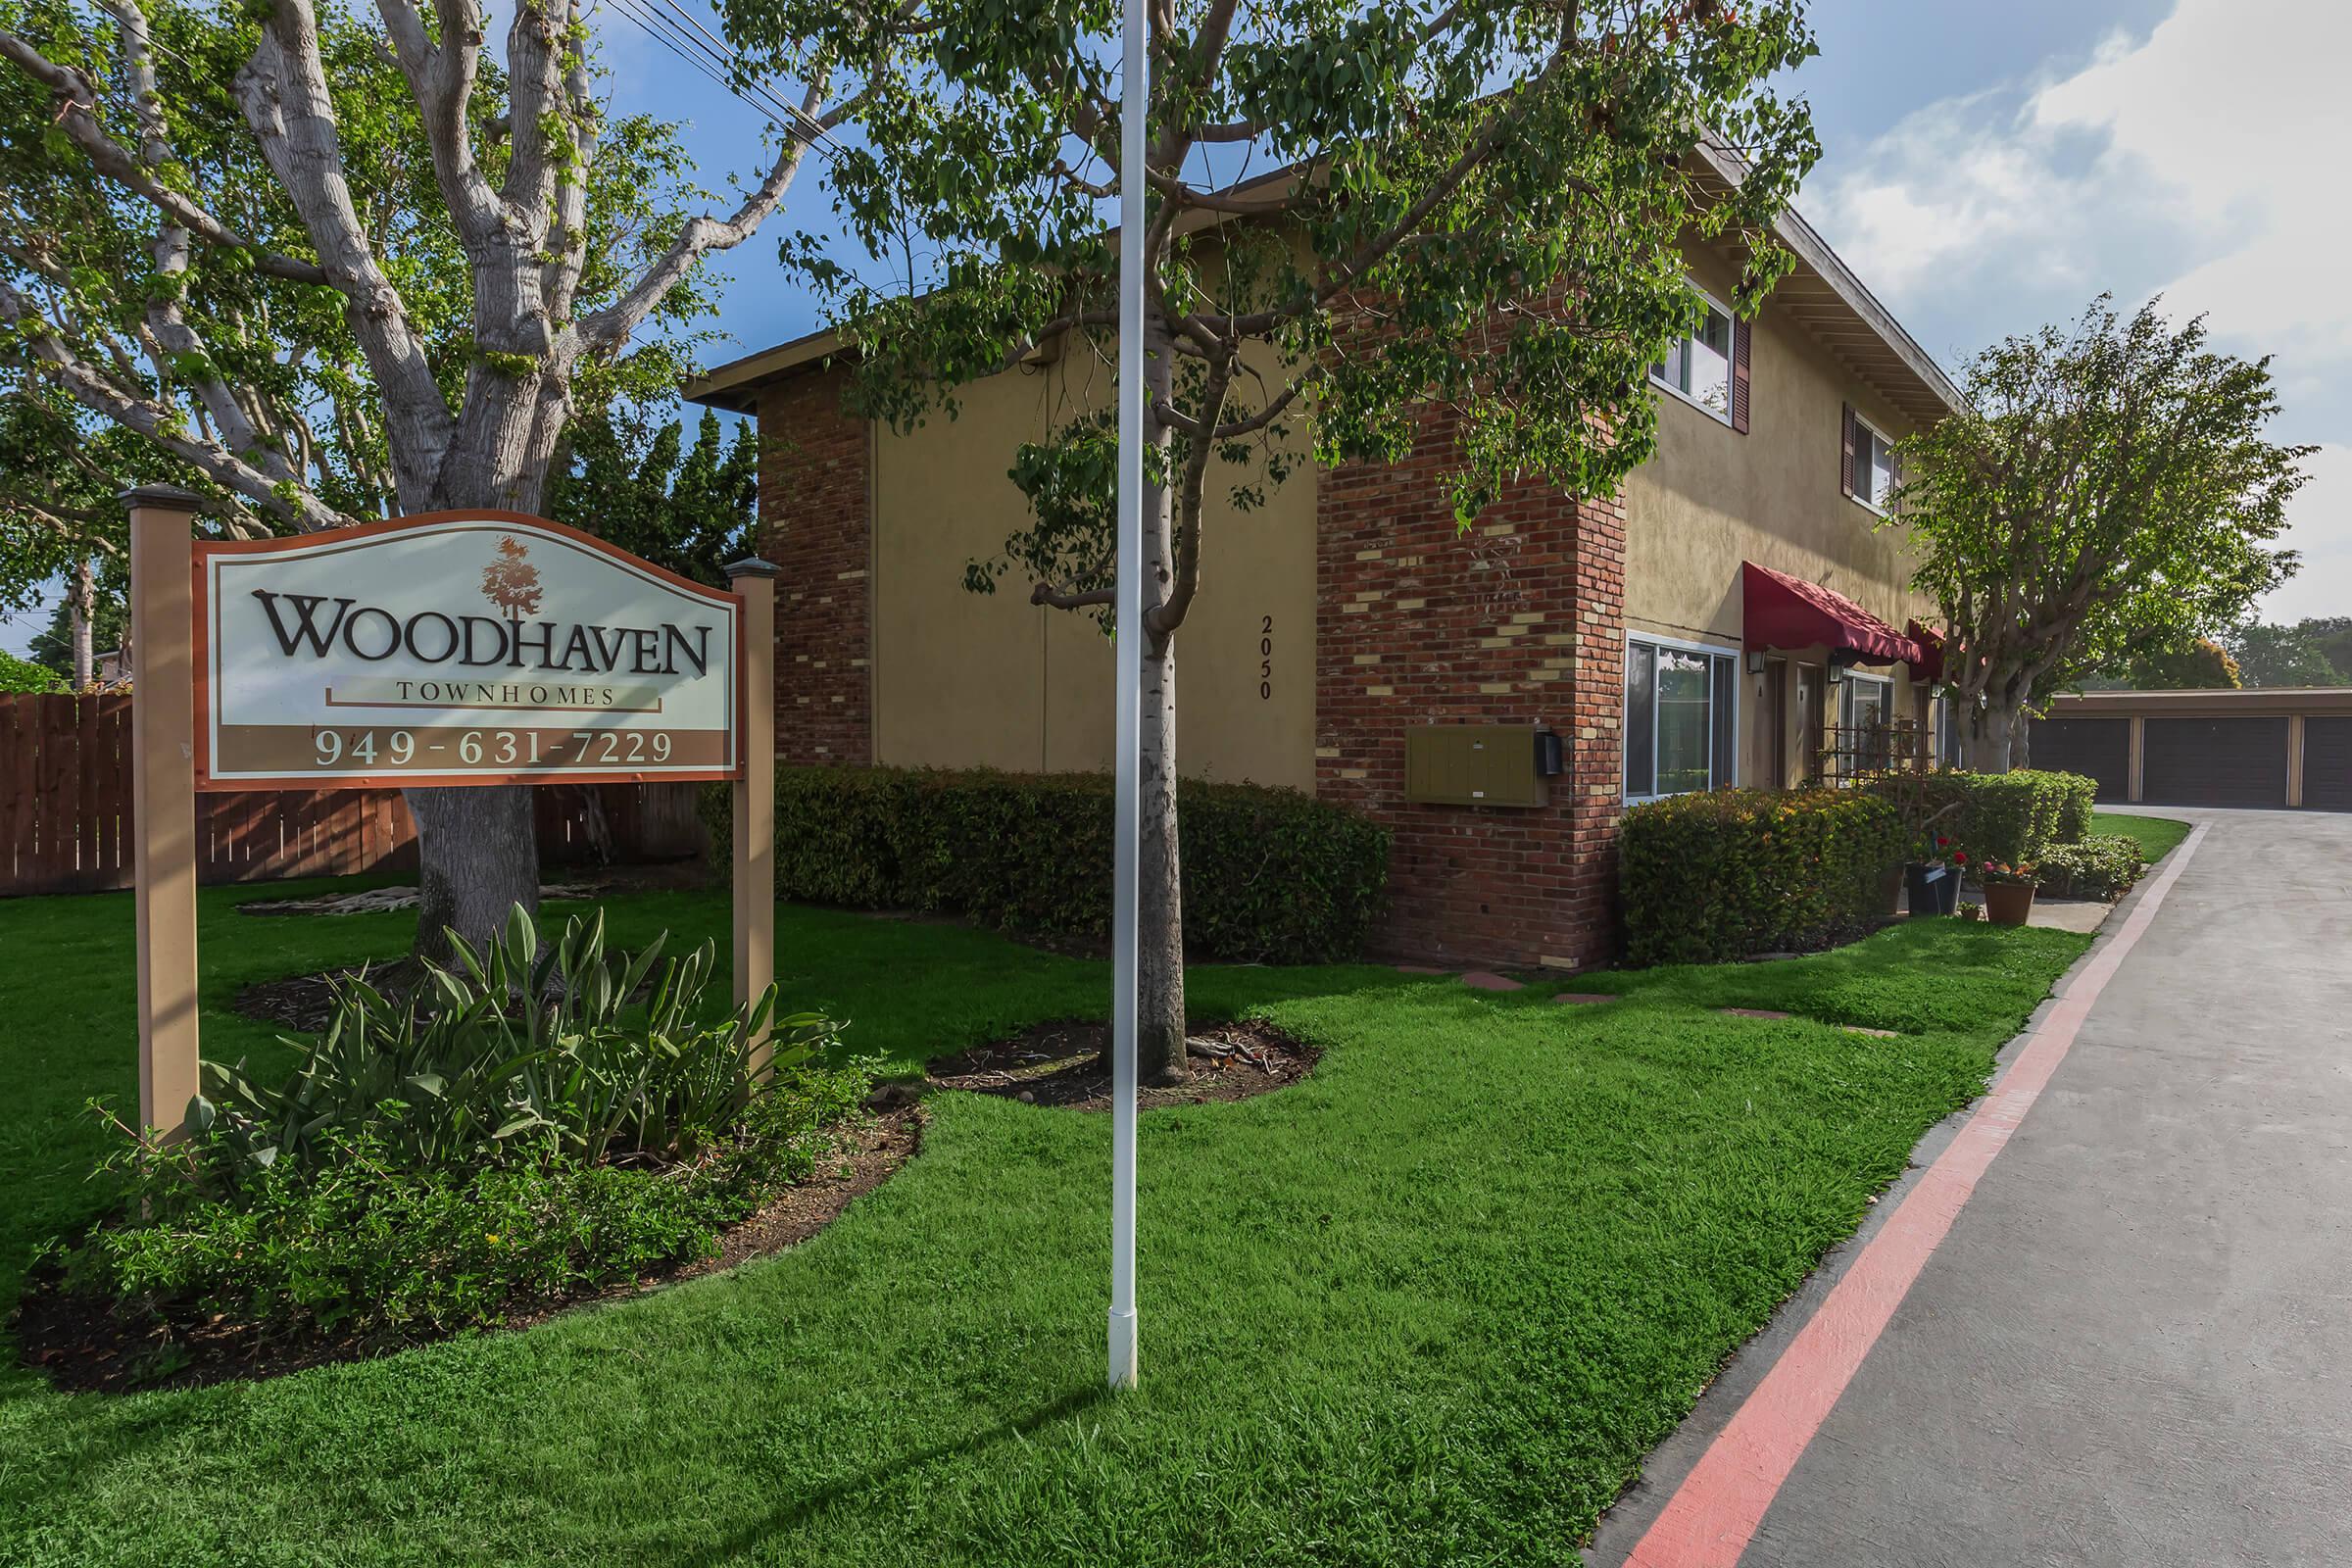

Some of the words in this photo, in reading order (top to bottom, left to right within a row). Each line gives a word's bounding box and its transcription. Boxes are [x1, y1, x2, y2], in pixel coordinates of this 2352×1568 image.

[251, 589, 712, 676] WOODHAVEN
[1260, 614, 1272, 700] 2050
[396, 681, 613, 706] TOWNHOMES
[315, 729, 672, 765] 949-631-7229
